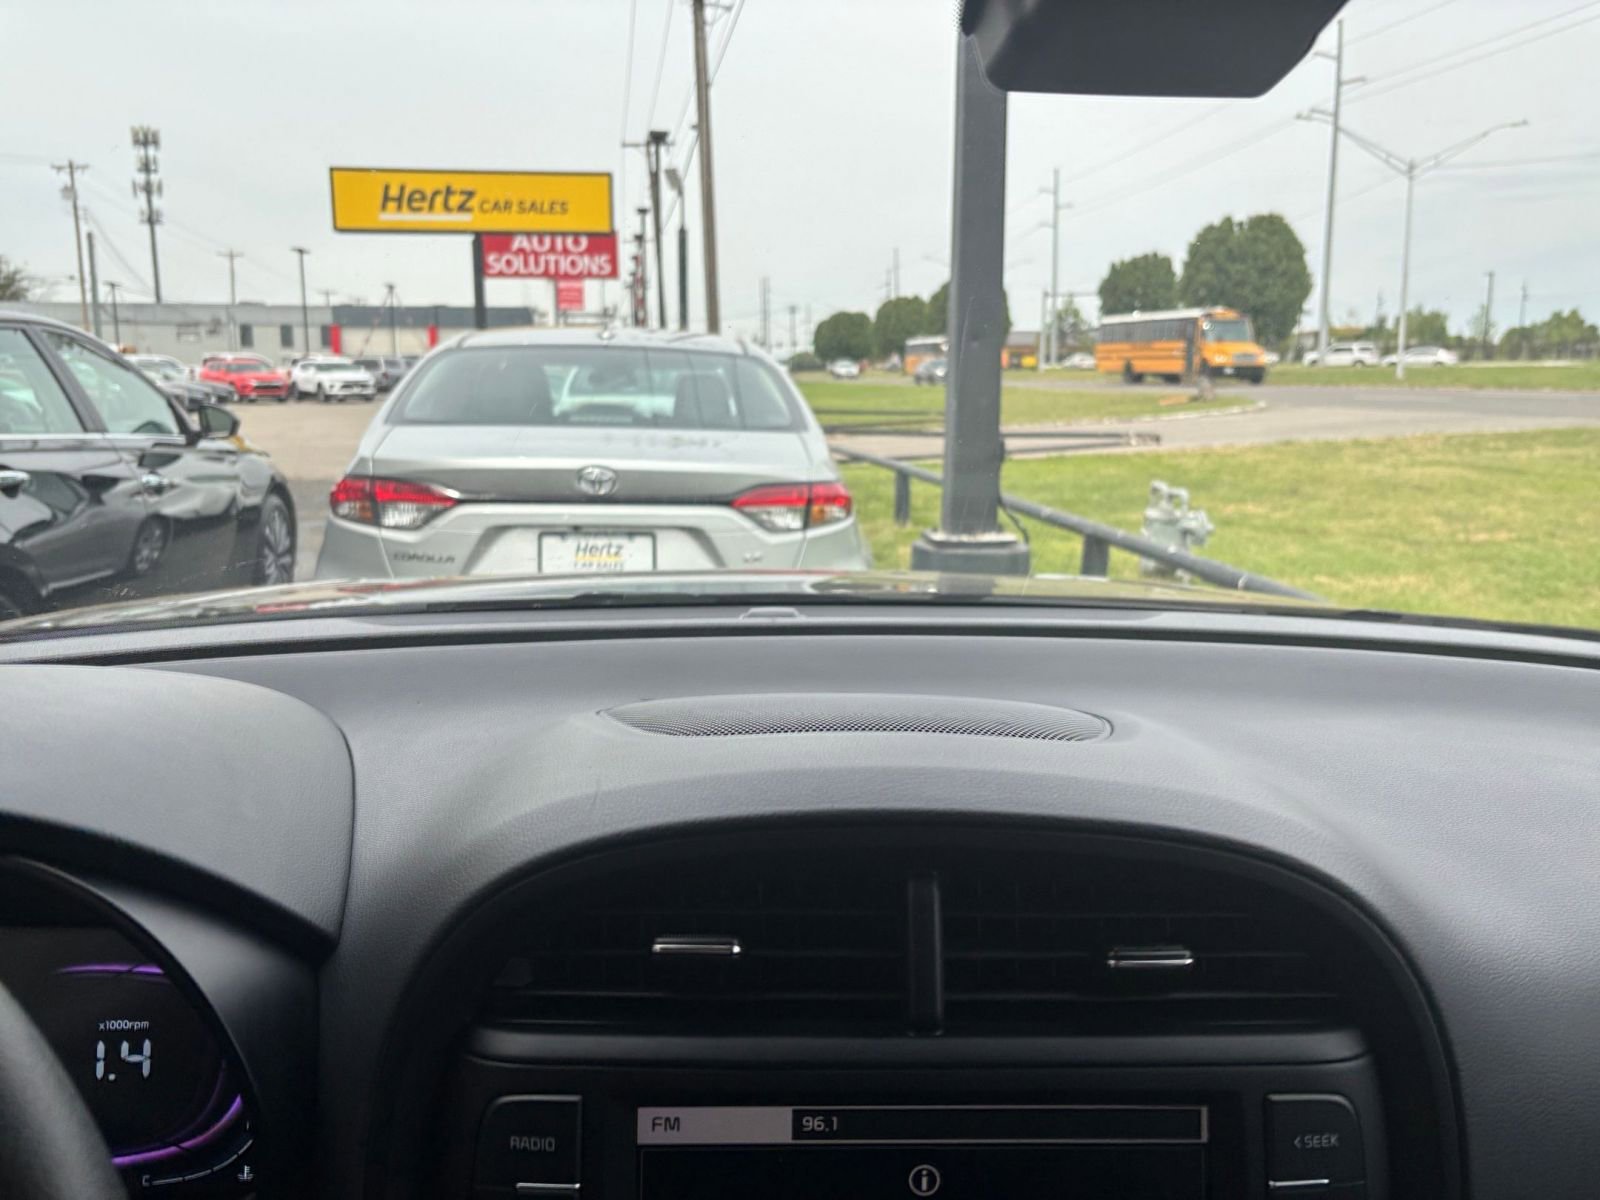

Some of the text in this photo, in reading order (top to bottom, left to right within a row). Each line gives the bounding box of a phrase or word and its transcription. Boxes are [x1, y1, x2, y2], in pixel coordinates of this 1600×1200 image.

[380, 184, 569, 216] Hertz CAR SALES
[511, 234, 588, 252] AUTO
[485, 253, 612, 276] SOLUTIONS
[575, 541, 624, 558] Hertz
[98, 1019, 150, 1031] x1000rpm
[96, 1038, 151, 1080] 1.4
[651, 1115, 839, 1133] FM 96.1
[509, 1136, 556, 1152] RADIO
